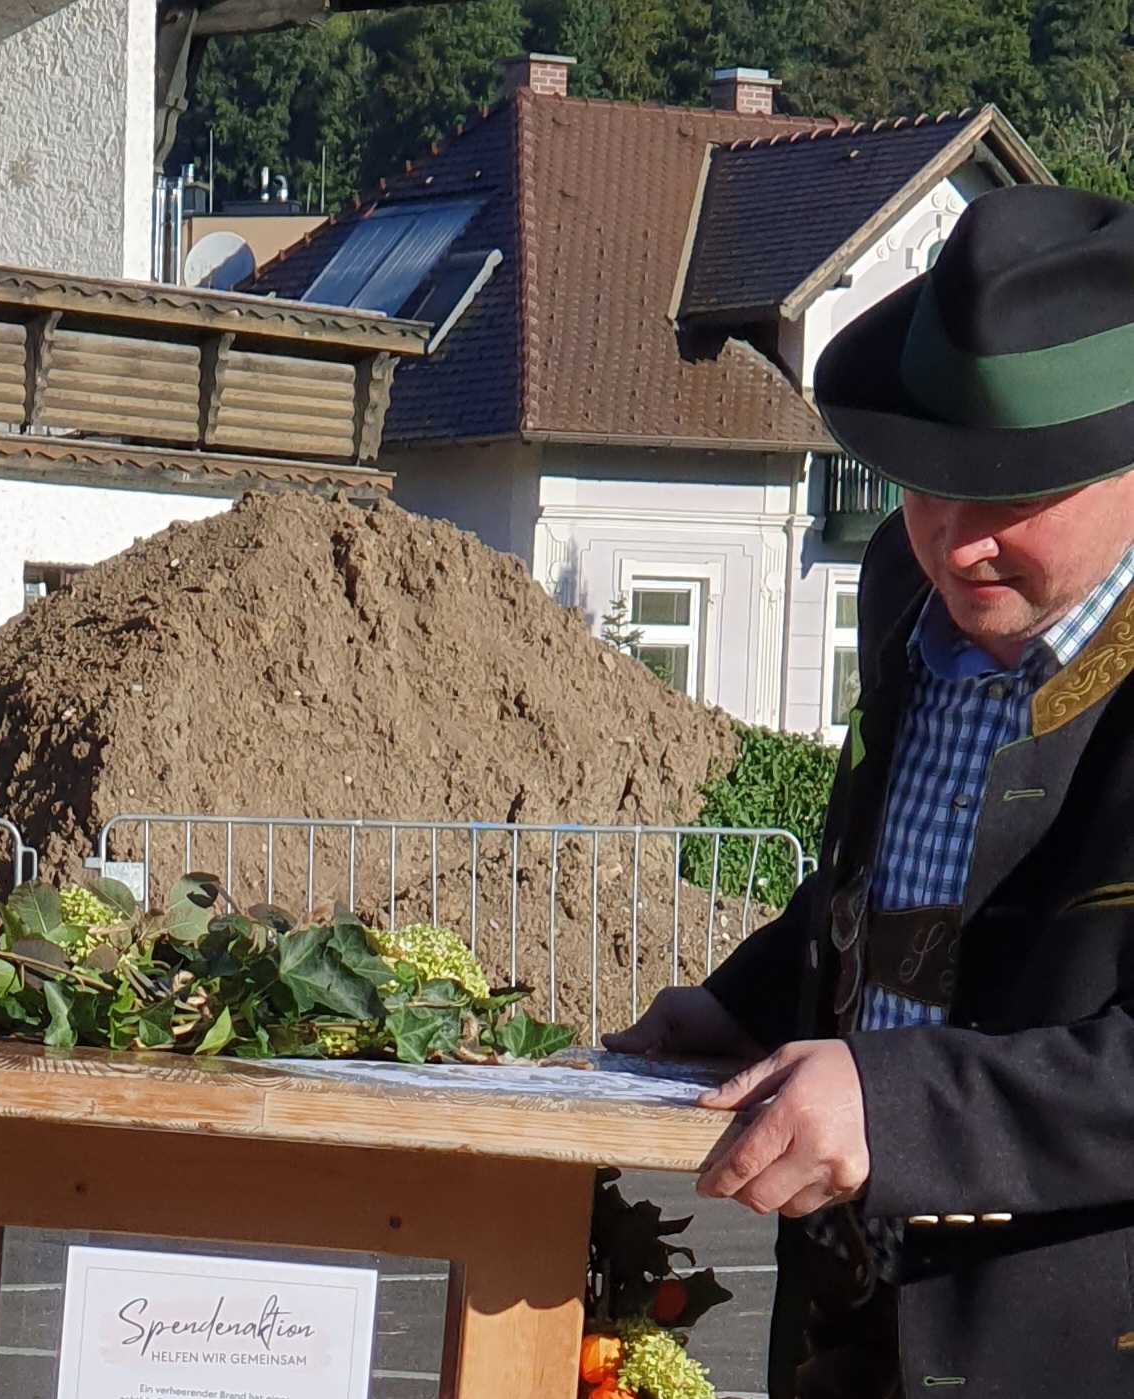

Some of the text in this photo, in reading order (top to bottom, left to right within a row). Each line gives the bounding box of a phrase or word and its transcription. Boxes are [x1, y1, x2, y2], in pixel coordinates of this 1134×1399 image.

[118, 1294, 315, 1356] Spendenaktion
[151, 1351, 307, 1365] HELFEN WIR GEMEINSAM
[140, 1384, 153, 1394] Ein
[156, 1386, 217, 1398] verheerender
